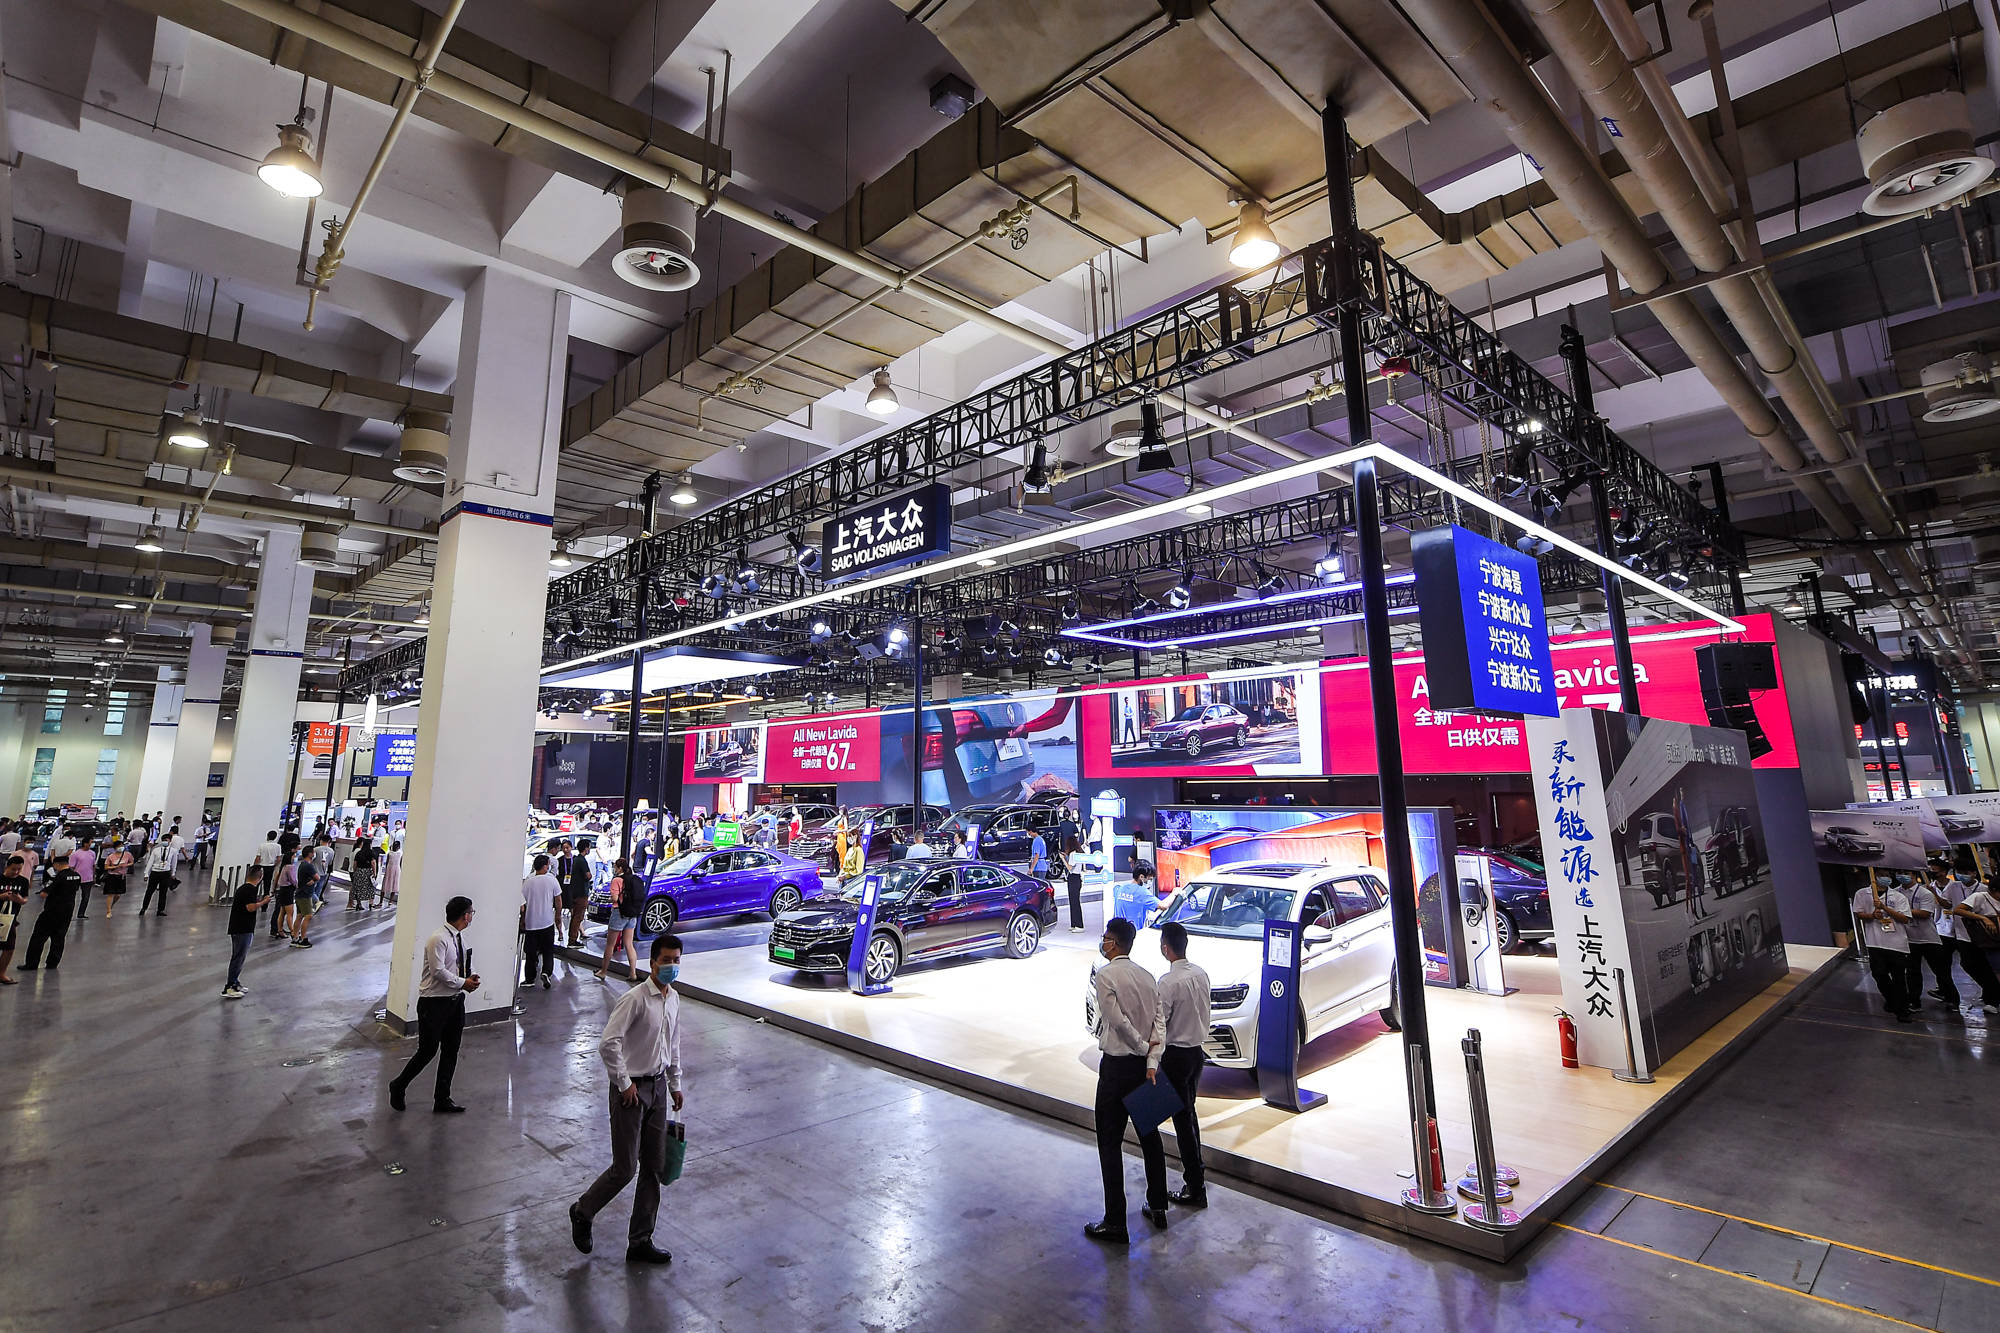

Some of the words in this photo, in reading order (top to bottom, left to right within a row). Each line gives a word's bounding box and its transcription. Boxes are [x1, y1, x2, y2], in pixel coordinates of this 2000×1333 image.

[831, 498, 924, 555] 上汽大众
[831, 554, 853, 572] SAIC
[853, 531, 924, 566] VOLKSWAGEN
[1479, 557, 1523, 596] 宁波海景
[1477, 589, 1533, 628] 宁波新众业
[1488, 626, 1533, 660] 兴宁达众
[1487, 658, 1543, 694] 宁波新众元
[793, 728, 805, 743] All
[806, 727, 827, 742] New
[827, 724, 858, 740] Lavida
[1447, 727, 1520, 747] 日供仅需
[826, 742, 851, 771] 67
